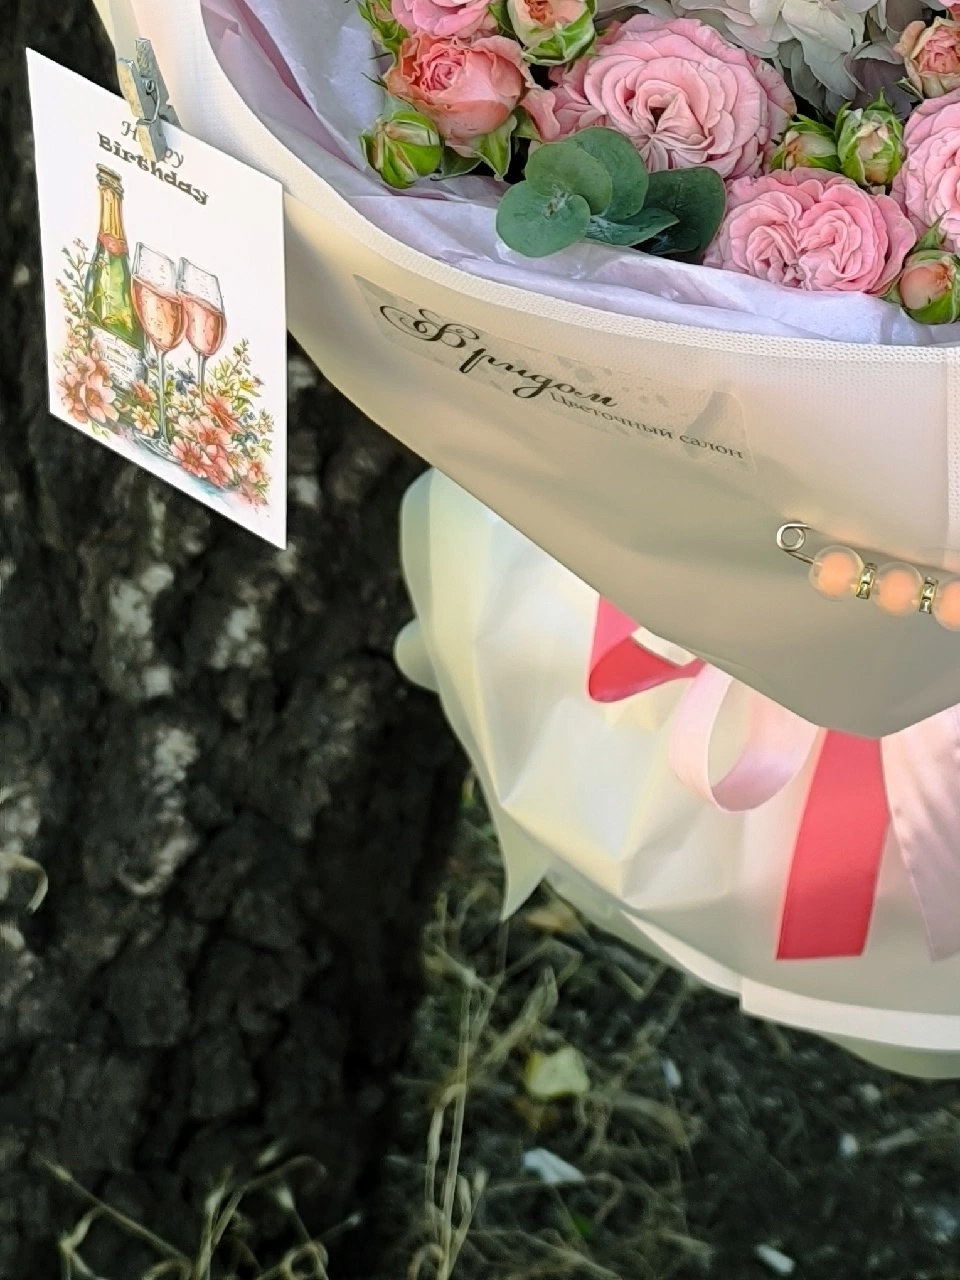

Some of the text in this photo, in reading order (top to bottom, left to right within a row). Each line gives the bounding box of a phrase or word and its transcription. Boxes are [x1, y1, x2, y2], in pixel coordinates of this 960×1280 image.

[97, 131, 209, 206] Birthday
[120, 120, 184, 169] Hpy
[550, 391, 744, 459] Цветочный салон
